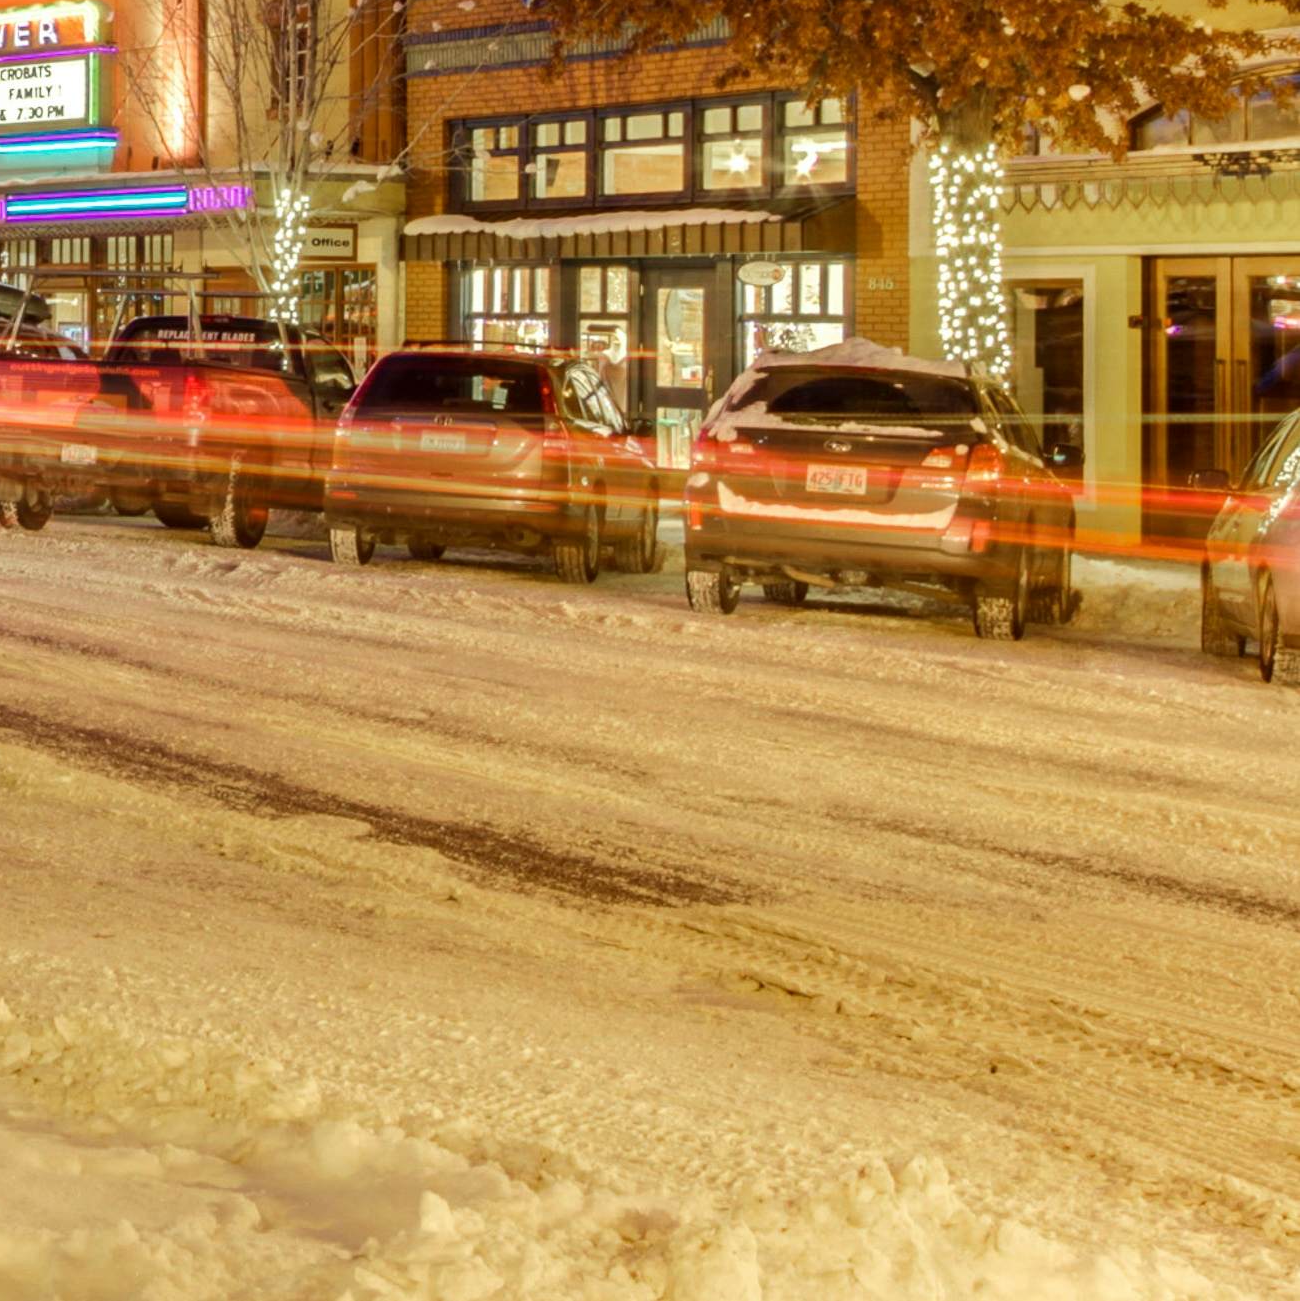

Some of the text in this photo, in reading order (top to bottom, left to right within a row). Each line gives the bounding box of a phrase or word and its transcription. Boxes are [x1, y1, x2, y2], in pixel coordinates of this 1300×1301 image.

[0, 109, 7, 121] &
[47, 104, 64, 118] PM
[311, 237, 350, 248] Office
[157, 329, 256, 342] REPLACENT BLADES
